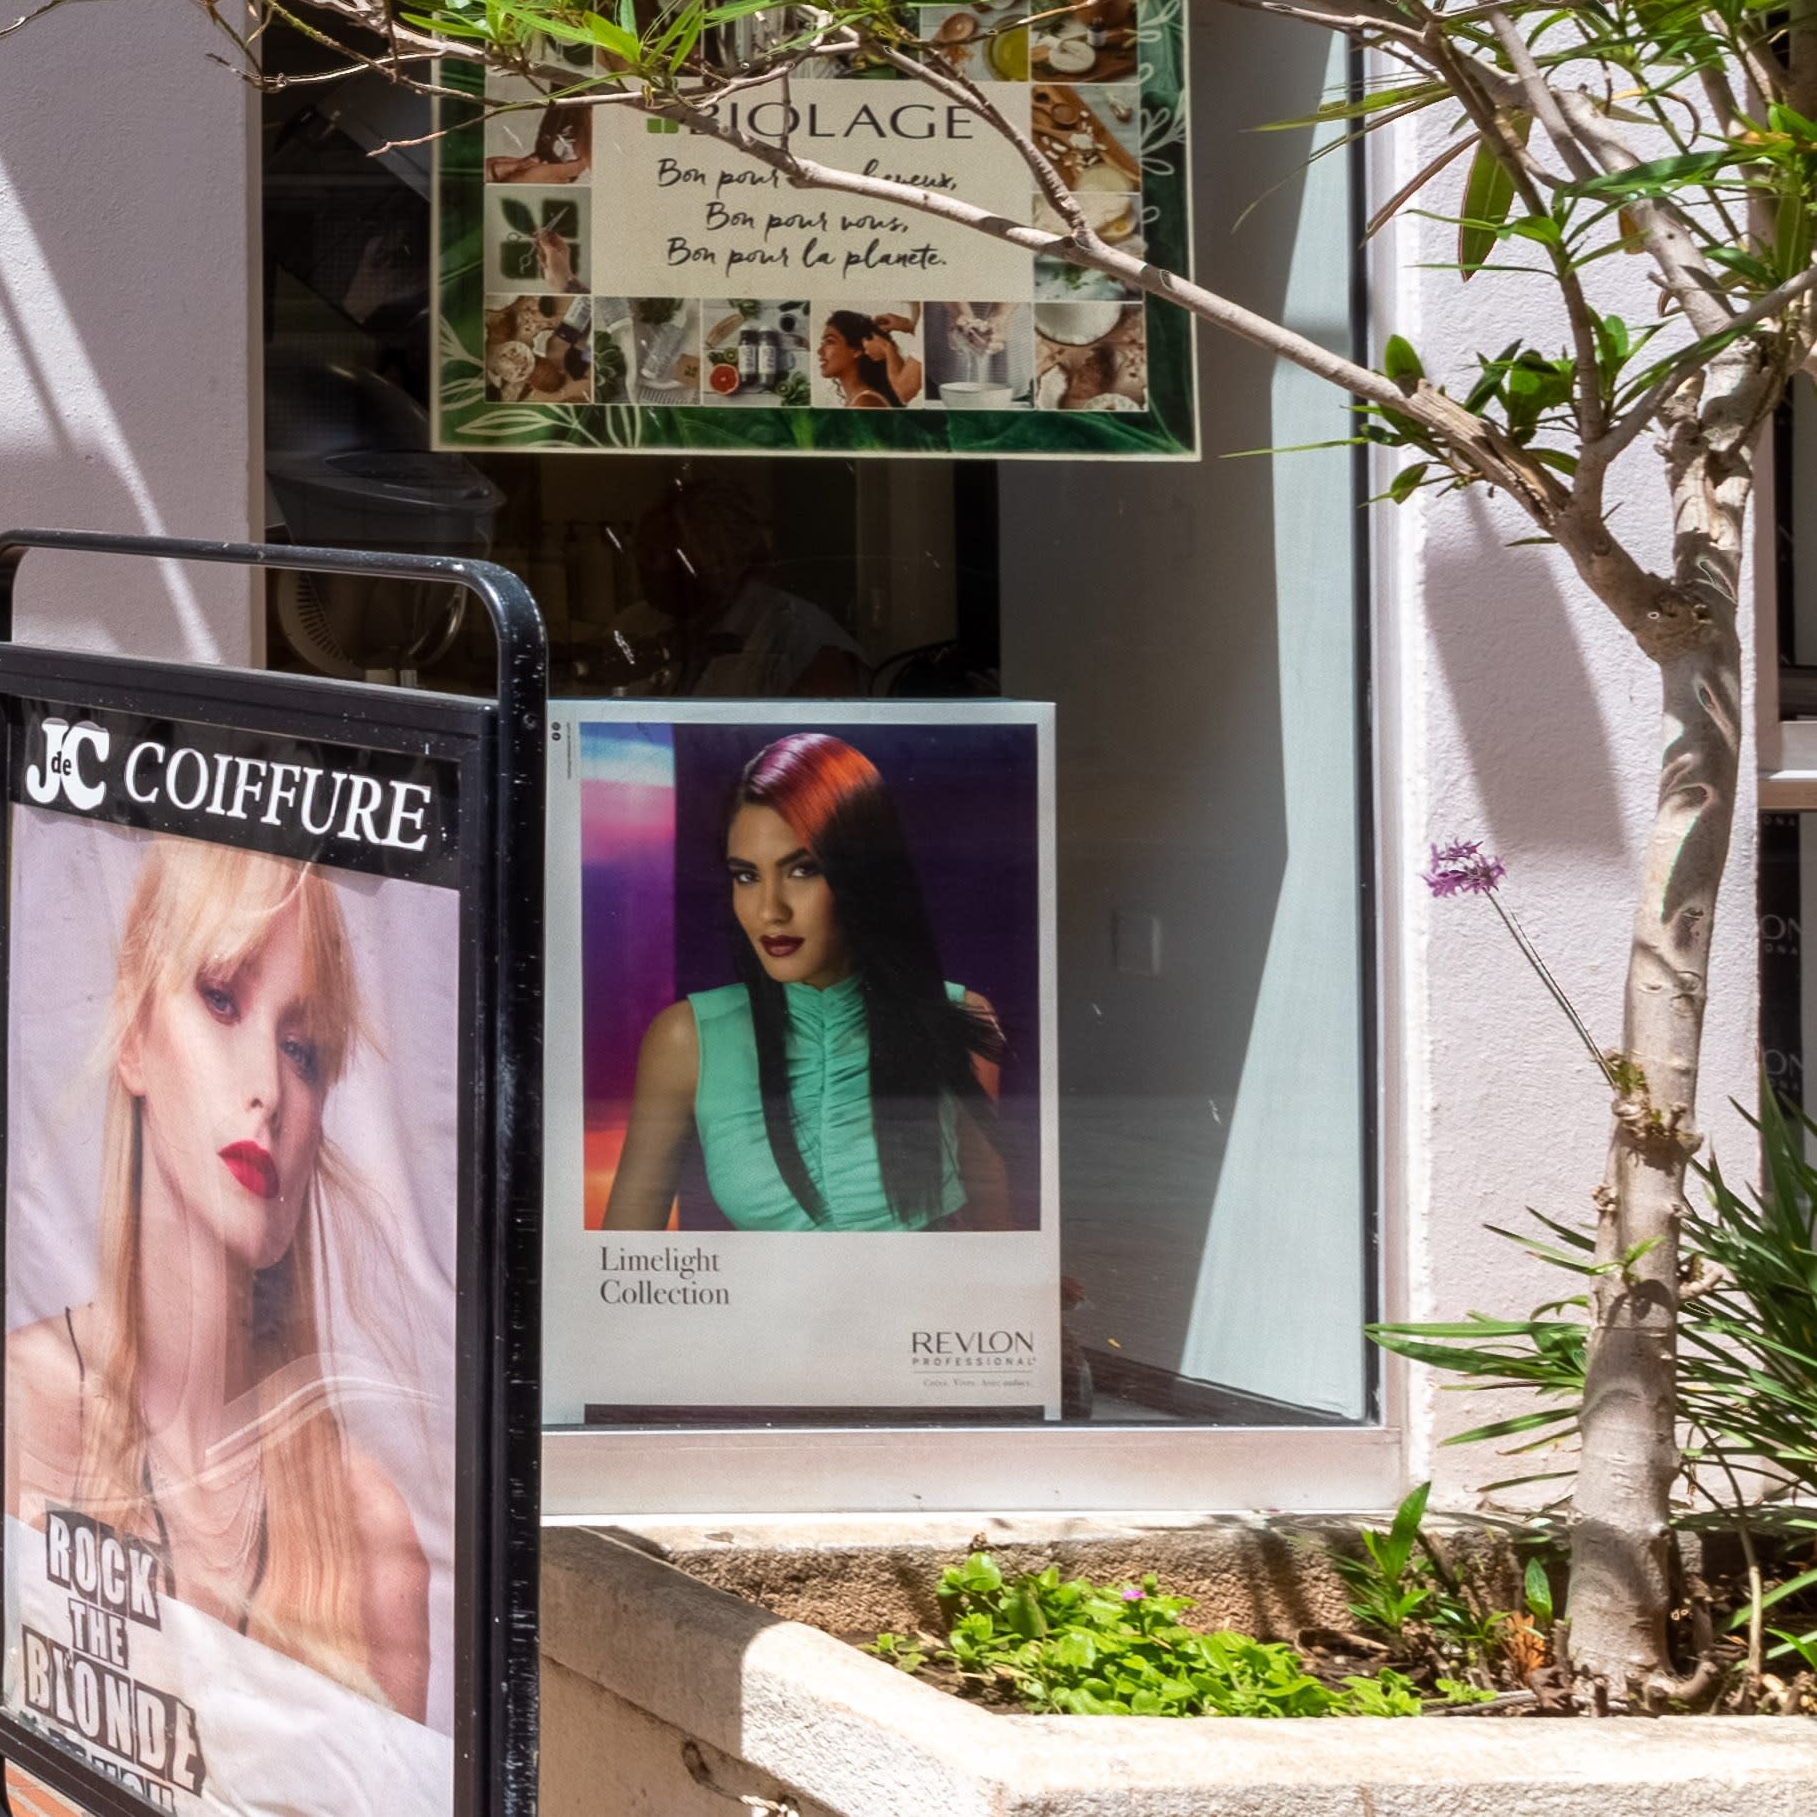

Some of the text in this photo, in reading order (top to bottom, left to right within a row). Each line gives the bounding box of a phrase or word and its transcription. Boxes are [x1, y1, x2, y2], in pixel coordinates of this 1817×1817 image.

[658, 157, 780, 200] Bon pour
[706, 201, 755, 231] Bon
[765, 211, 827, 243] pour
[667, 237, 835, 278] Bon pour la
[51, 750, 72, 777] de
[123, 741, 432, 852] COIFFURE
[599, 1245, 721, 1280] Limelight
[599, 1278, 730, 1305] Collection
[911, 1330, 1034, 1354] REVLON
[48, 1513, 158, 1620] ROCK
[70, 1602, 125, 1667] THE
[25, 1630, 198, 1792] BLONDE
